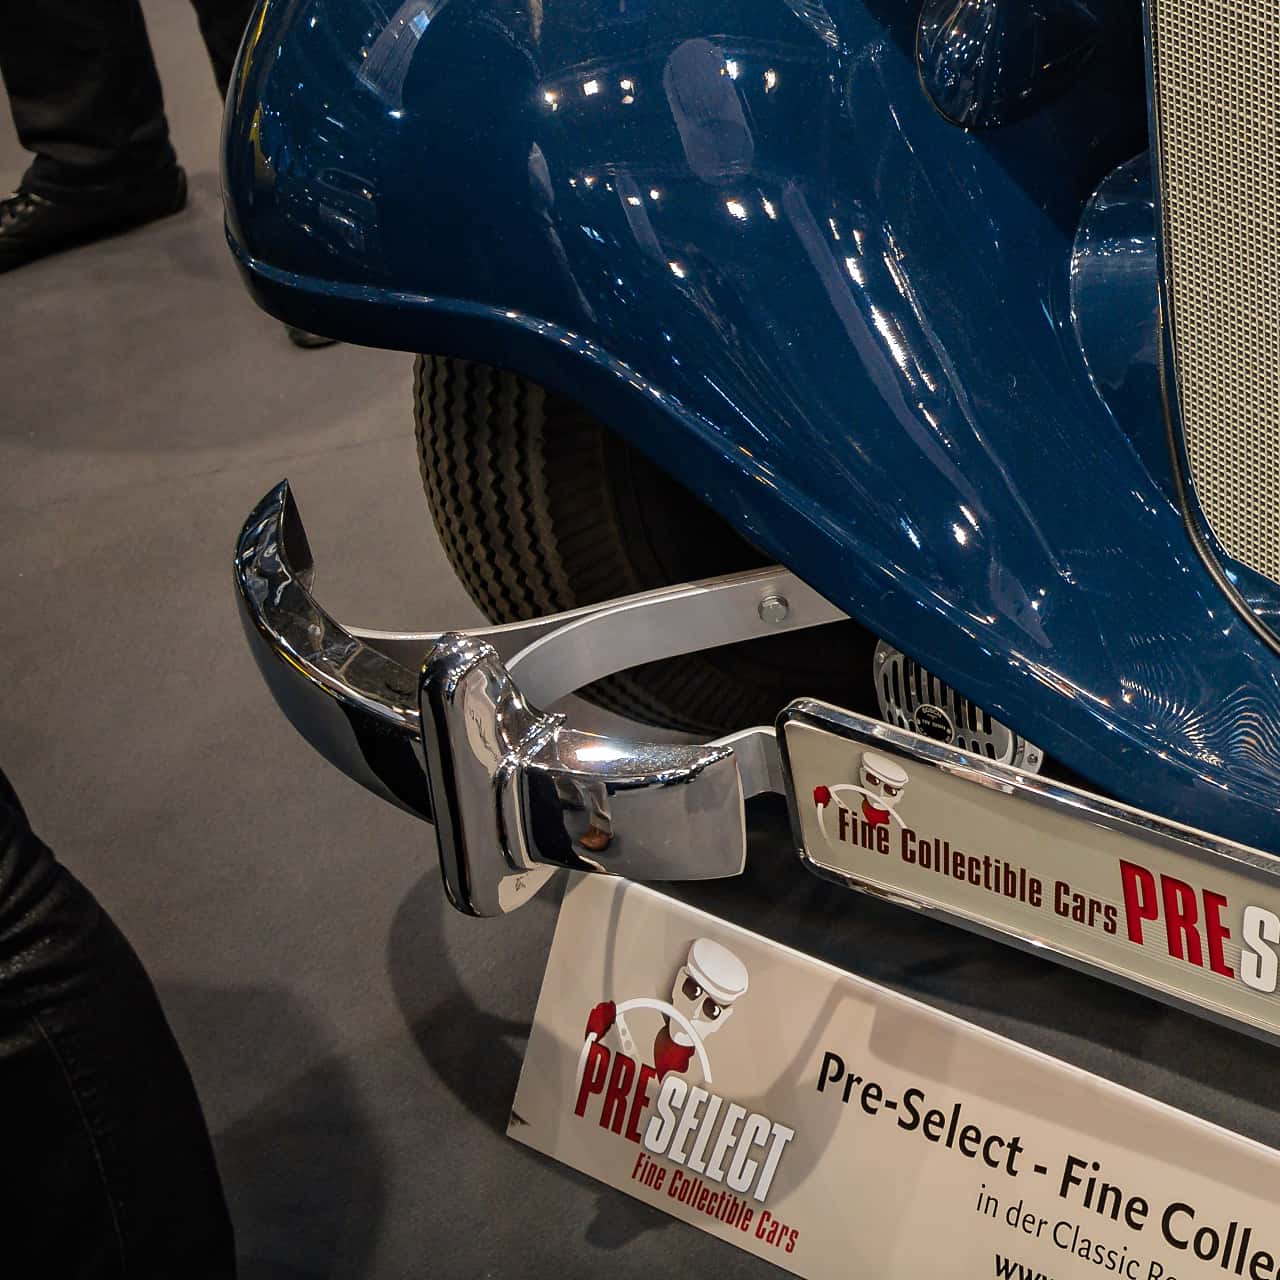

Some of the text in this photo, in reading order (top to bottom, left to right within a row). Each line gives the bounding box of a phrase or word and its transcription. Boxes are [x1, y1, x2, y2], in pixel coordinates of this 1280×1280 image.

[838, 806, 890, 855] Fine
[901, 827, 1042, 908] Collectible
[1054, 879, 1118, 935] Cars
[816, 1051, 1024, 1177] Pre-Select
[1058, 1155, 1150, 1230] Fine
[631, 1152, 799, 1254] Fine Collectible Cars
[976, 1183, 999, 1218] in
[1006, 1201, 1049, 1238] der
[1053, 1222, 1141, 1280] Classic
